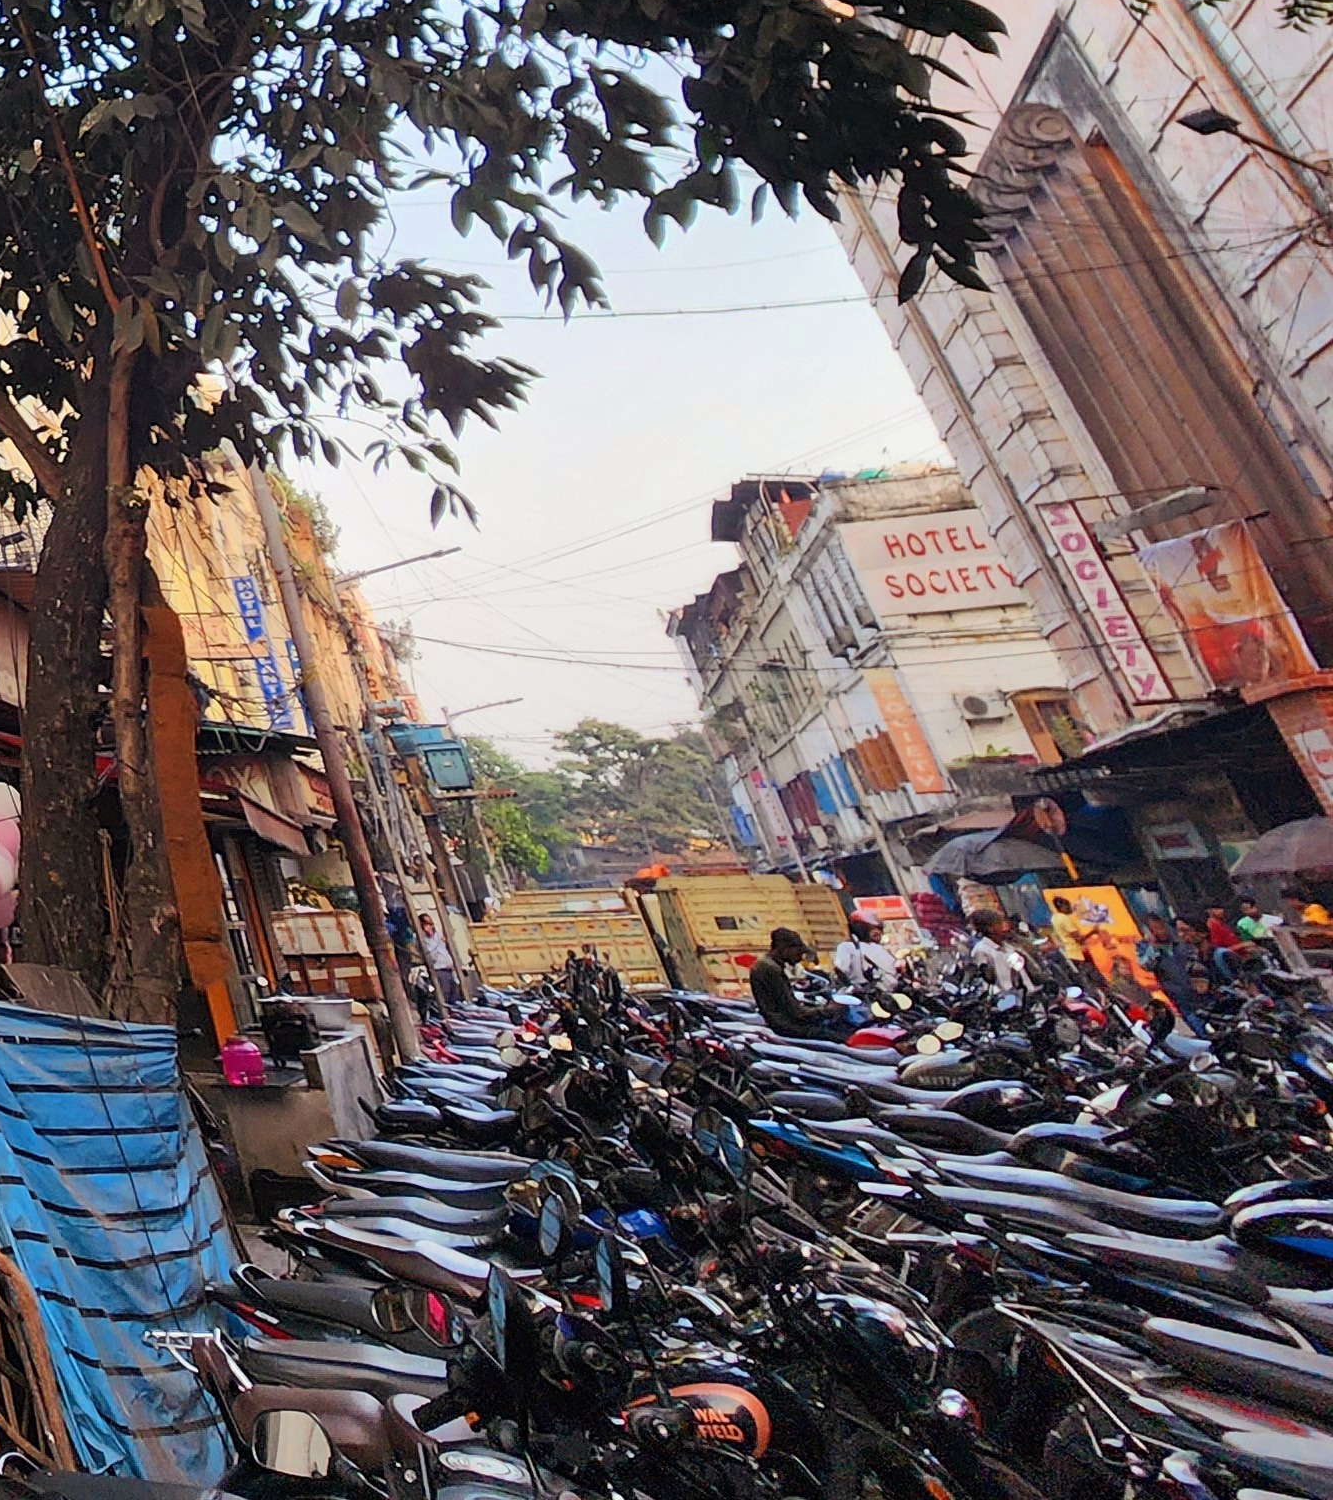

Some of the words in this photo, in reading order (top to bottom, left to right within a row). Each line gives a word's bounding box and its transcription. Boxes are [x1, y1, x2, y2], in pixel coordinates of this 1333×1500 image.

[884, 525, 987, 559] HOTEL
[1046, 504, 1156, 696] SOCIETY
[692, 1407, 730, 1423] YAL
[697, 1423, 744, 1443] FIELD
